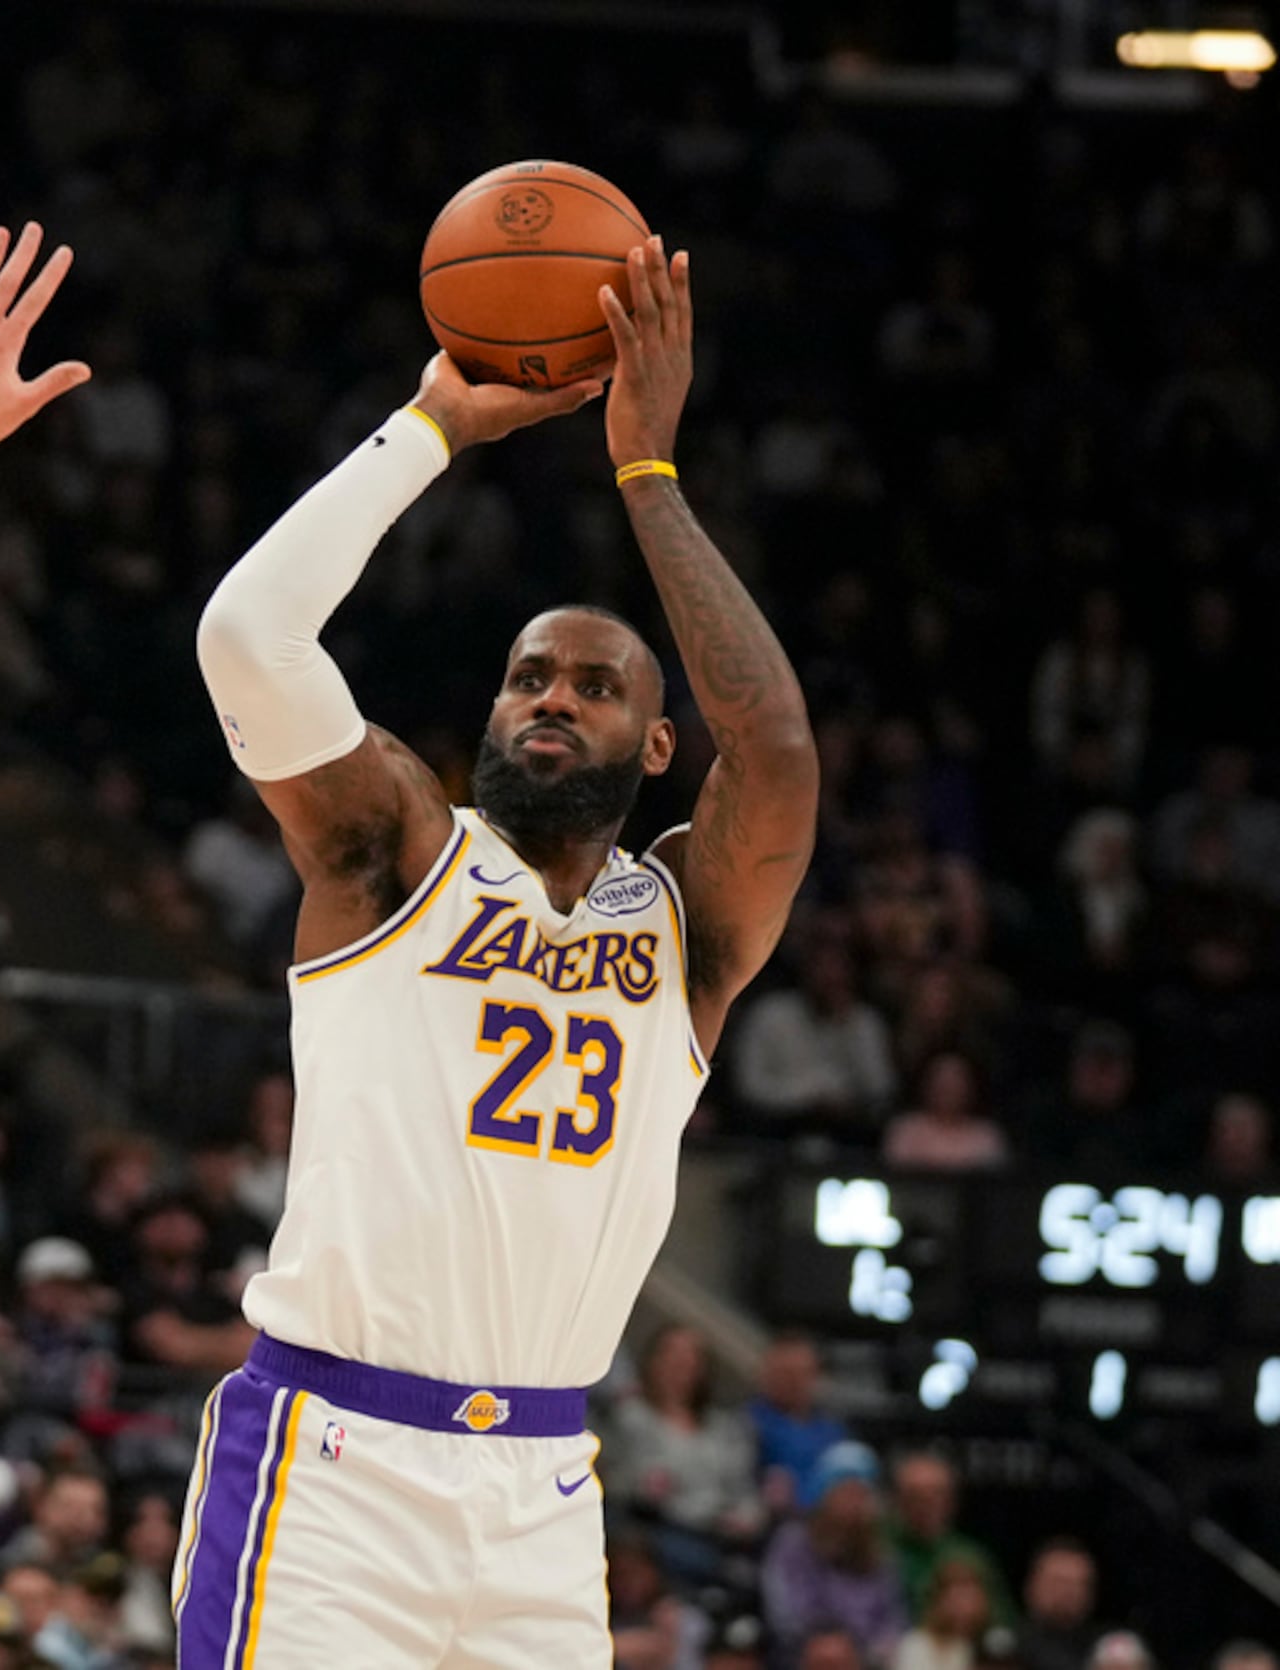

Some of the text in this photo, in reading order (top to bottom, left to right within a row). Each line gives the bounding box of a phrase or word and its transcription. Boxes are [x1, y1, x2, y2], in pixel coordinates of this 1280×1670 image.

[593, 882, 654, 906] bibigo
[421, 895, 659, 1004] LAKERS
[465, 997, 625, 1169] 23
[1037, 1182, 1224, 1288] 5:24
